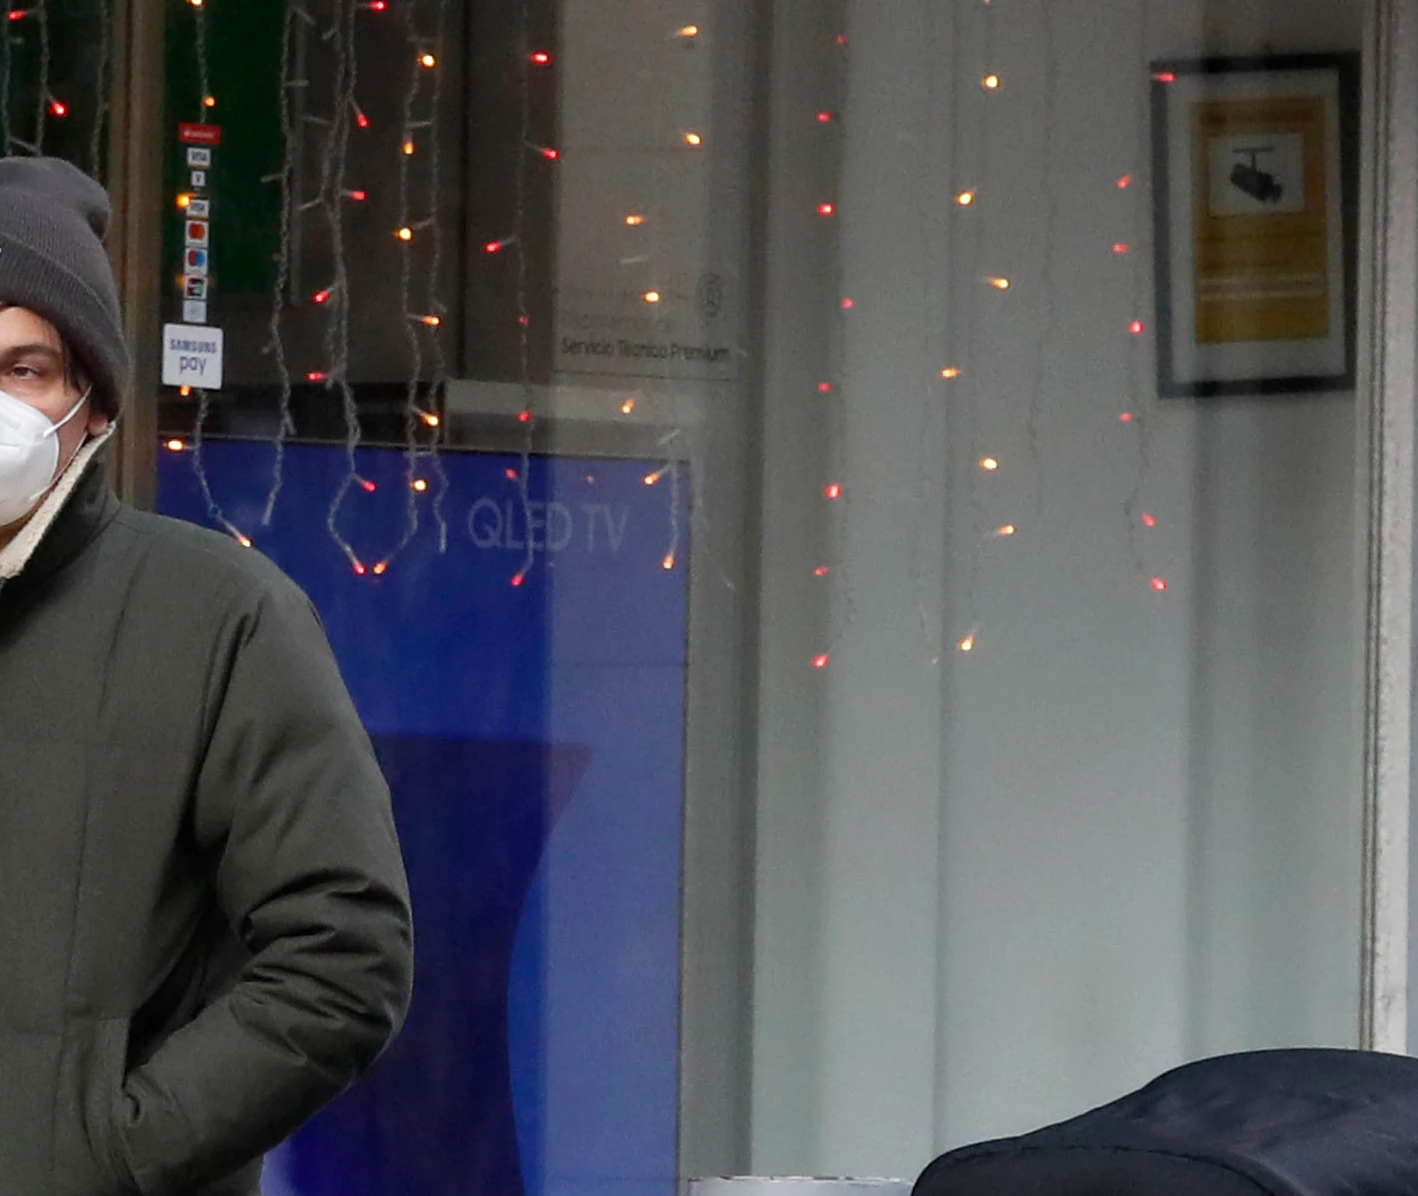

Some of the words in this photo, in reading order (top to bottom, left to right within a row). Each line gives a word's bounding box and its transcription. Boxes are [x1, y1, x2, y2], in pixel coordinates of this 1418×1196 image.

[169, 338, 217, 354] SAMSUNG
[179, 355, 207, 376] pay
[467, 497, 573, 551] QLED
[580, 502, 633, 553] TV
